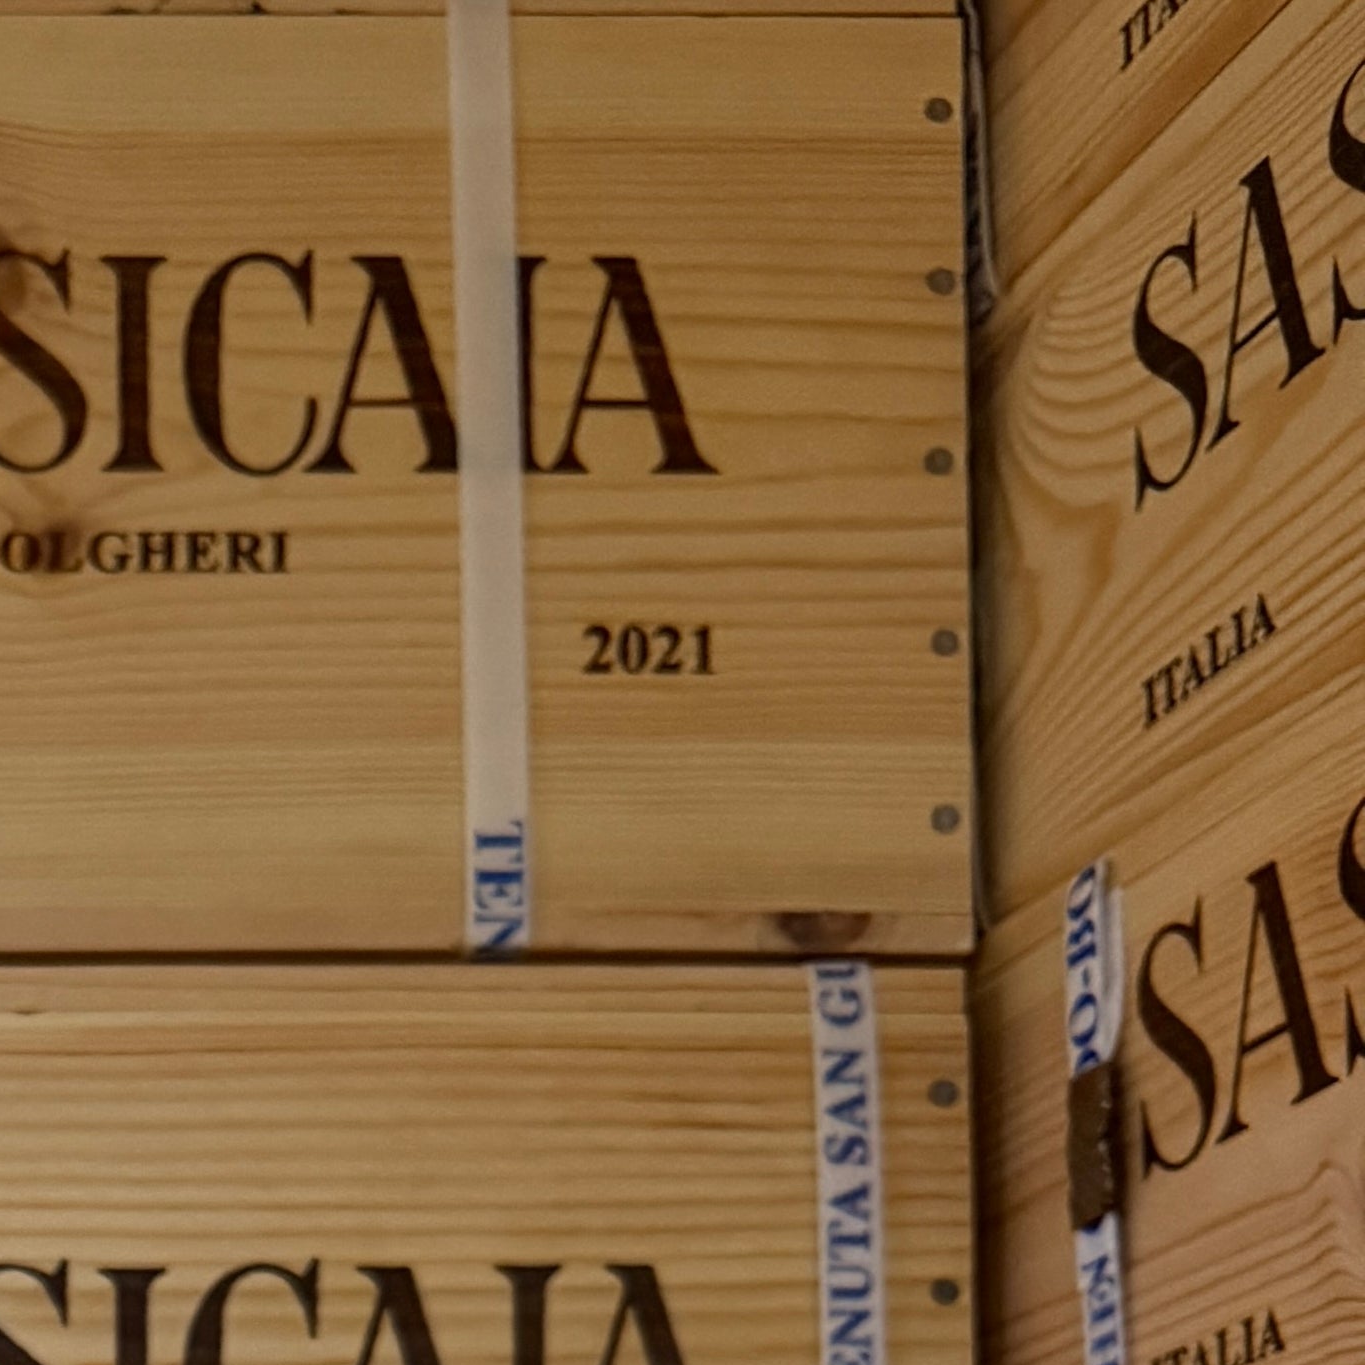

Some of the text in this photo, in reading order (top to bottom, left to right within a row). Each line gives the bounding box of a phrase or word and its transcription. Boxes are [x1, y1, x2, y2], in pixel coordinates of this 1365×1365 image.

[581, 624, 716, 676] 2021
[1141, 593, 1277, 731] ITALIA
[821, 1048, 869, 1166] SAN
